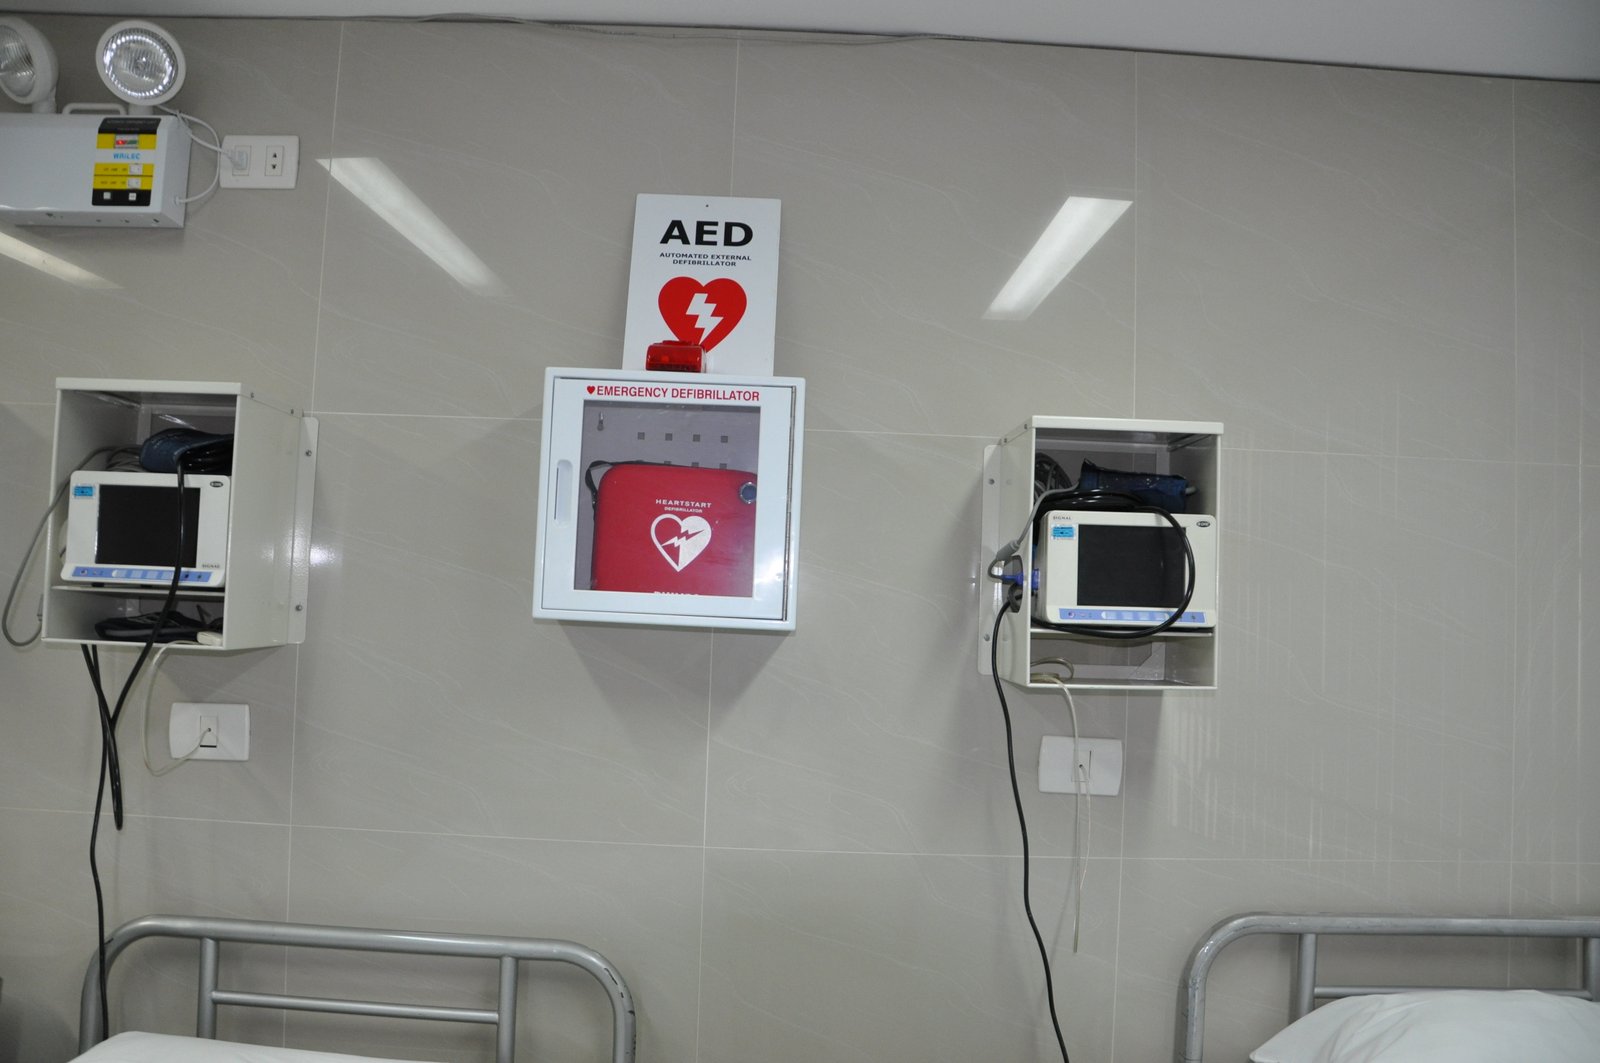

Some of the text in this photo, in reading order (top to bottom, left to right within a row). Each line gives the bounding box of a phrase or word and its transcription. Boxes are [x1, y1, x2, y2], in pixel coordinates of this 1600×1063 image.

[659, 219, 754, 247] AED
[659, 252, 709, 260] AUTOMATED
[672, 259, 737, 267] DEFIBRILLATOR
[596, 385, 760, 401] EMERGENCY DEFIBRILLATOR
[655, 499, 712, 508] HEARTSTART
